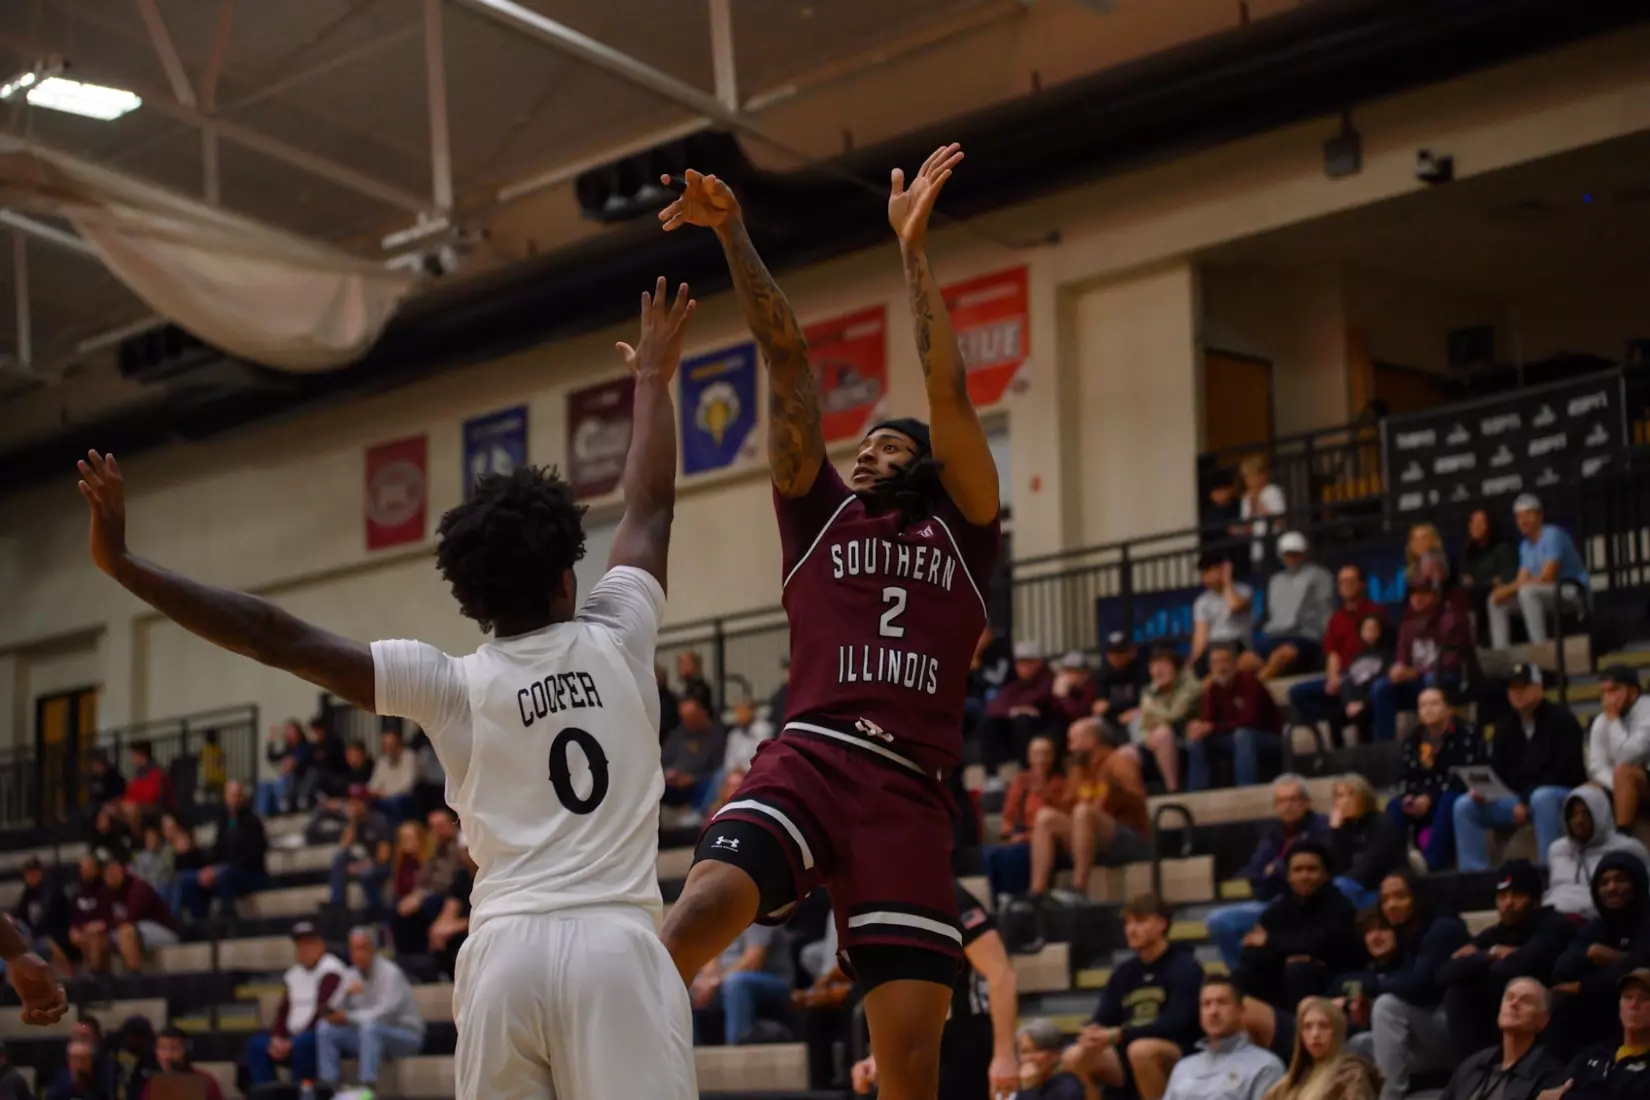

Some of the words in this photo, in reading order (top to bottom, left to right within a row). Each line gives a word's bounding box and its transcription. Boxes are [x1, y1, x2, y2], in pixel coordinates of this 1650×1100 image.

[831, 537, 955, 591] SOUTHERN
[880, 586, 907, 637] 2
[839, 645, 938, 694] ILLINOIS
[517, 672, 603, 727] COOPER
[548, 727, 609, 815] 0
